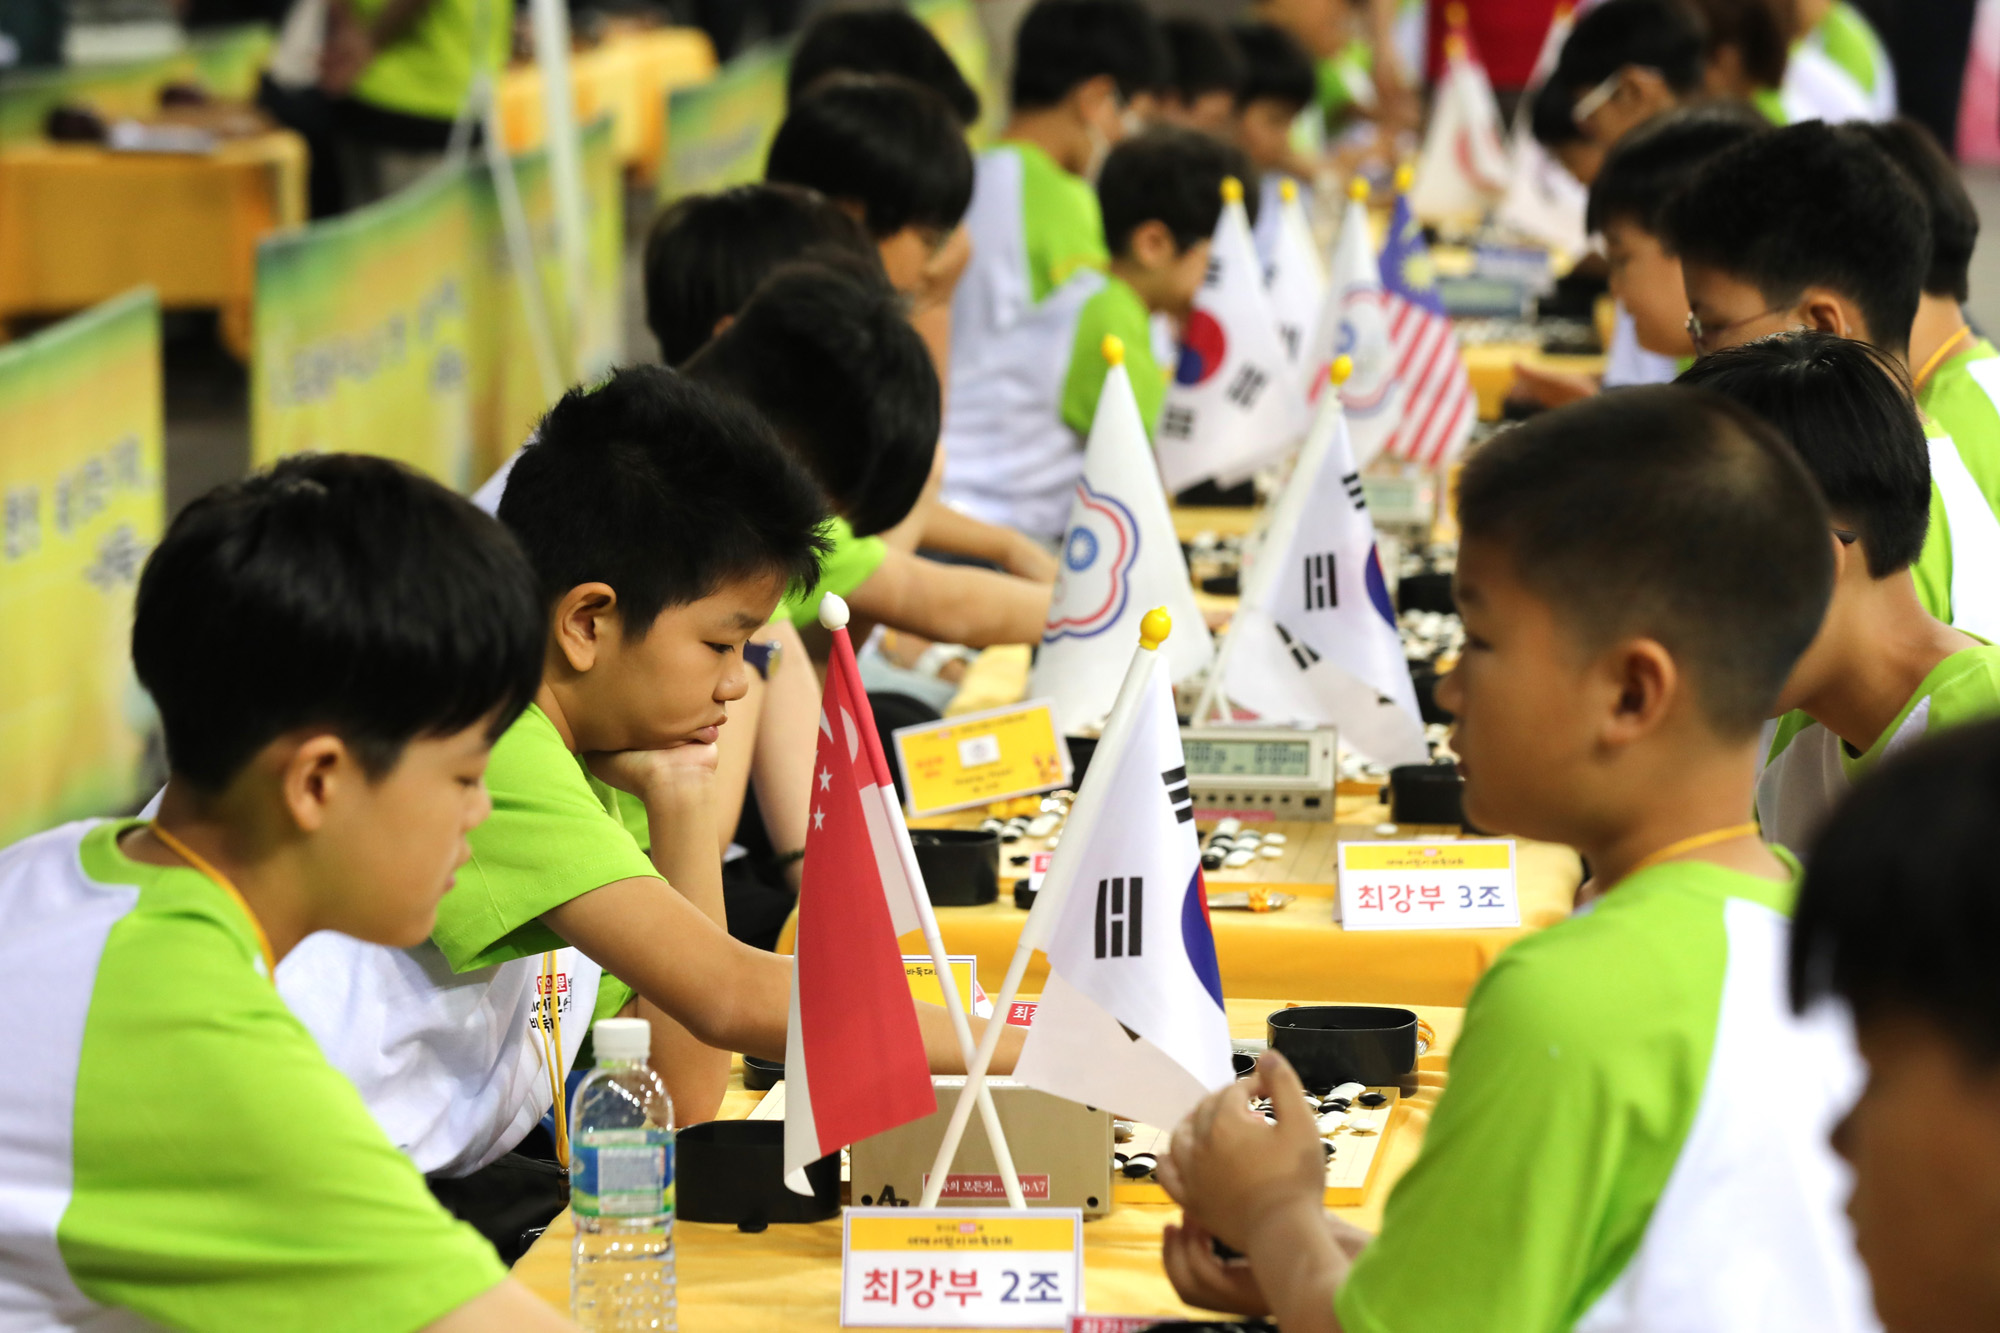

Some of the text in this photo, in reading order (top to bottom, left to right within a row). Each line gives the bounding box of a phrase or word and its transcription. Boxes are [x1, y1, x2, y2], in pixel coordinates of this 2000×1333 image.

[1357, 884, 1505, 914] 최강부 3조
[906, 966, 938, 977] 바둑대
[862, 1268, 1063, 1309] 최강부 2조
